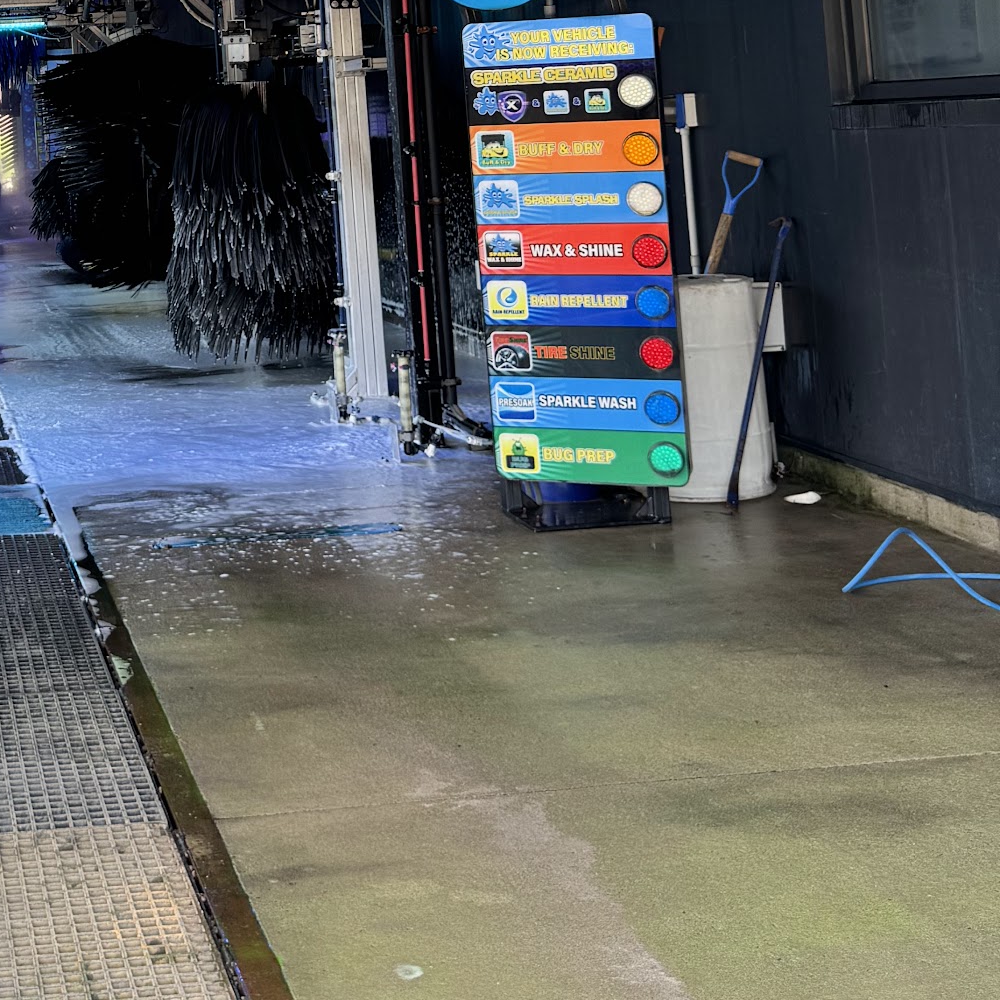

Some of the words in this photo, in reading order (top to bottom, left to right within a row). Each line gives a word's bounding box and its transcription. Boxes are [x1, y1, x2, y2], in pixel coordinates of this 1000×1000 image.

[510, 29, 551, 45] YOUR
[552, 26, 616, 42] VEHICLE
[496, 48, 510, 61] IS
[511, 45, 546, 60] NOW
[549, 41, 635, 58] RECEIVING:
[471, 68, 542, 87] SPARKLE
[543, 64, 618, 84] CERAMIC
[518, 142, 556, 157] BUFF
[558, 141, 571, 156] &
[573, 140, 604, 155] DRY
[523, 194, 573, 206] SPARKLE
[574, 193, 620, 205] SPLASH
[530, 244, 563, 258] WAX
[564, 243, 576, 258] &
[578, 243, 624, 258] SHINE
[530, 294, 559, 308] RAIN
[560, 294, 629, 308] REPELLENT
[534, 345, 568, 360] TIRE
[569, 346, 616, 360] SHINE
[499, 397, 533, 408] PRESOAK
[538, 394, 597, 409] SPARKLE
[599, 396, 637, 410] WASH
[542, 447, 575, 462] BUG
[576, 448, 616, 465] PREP
